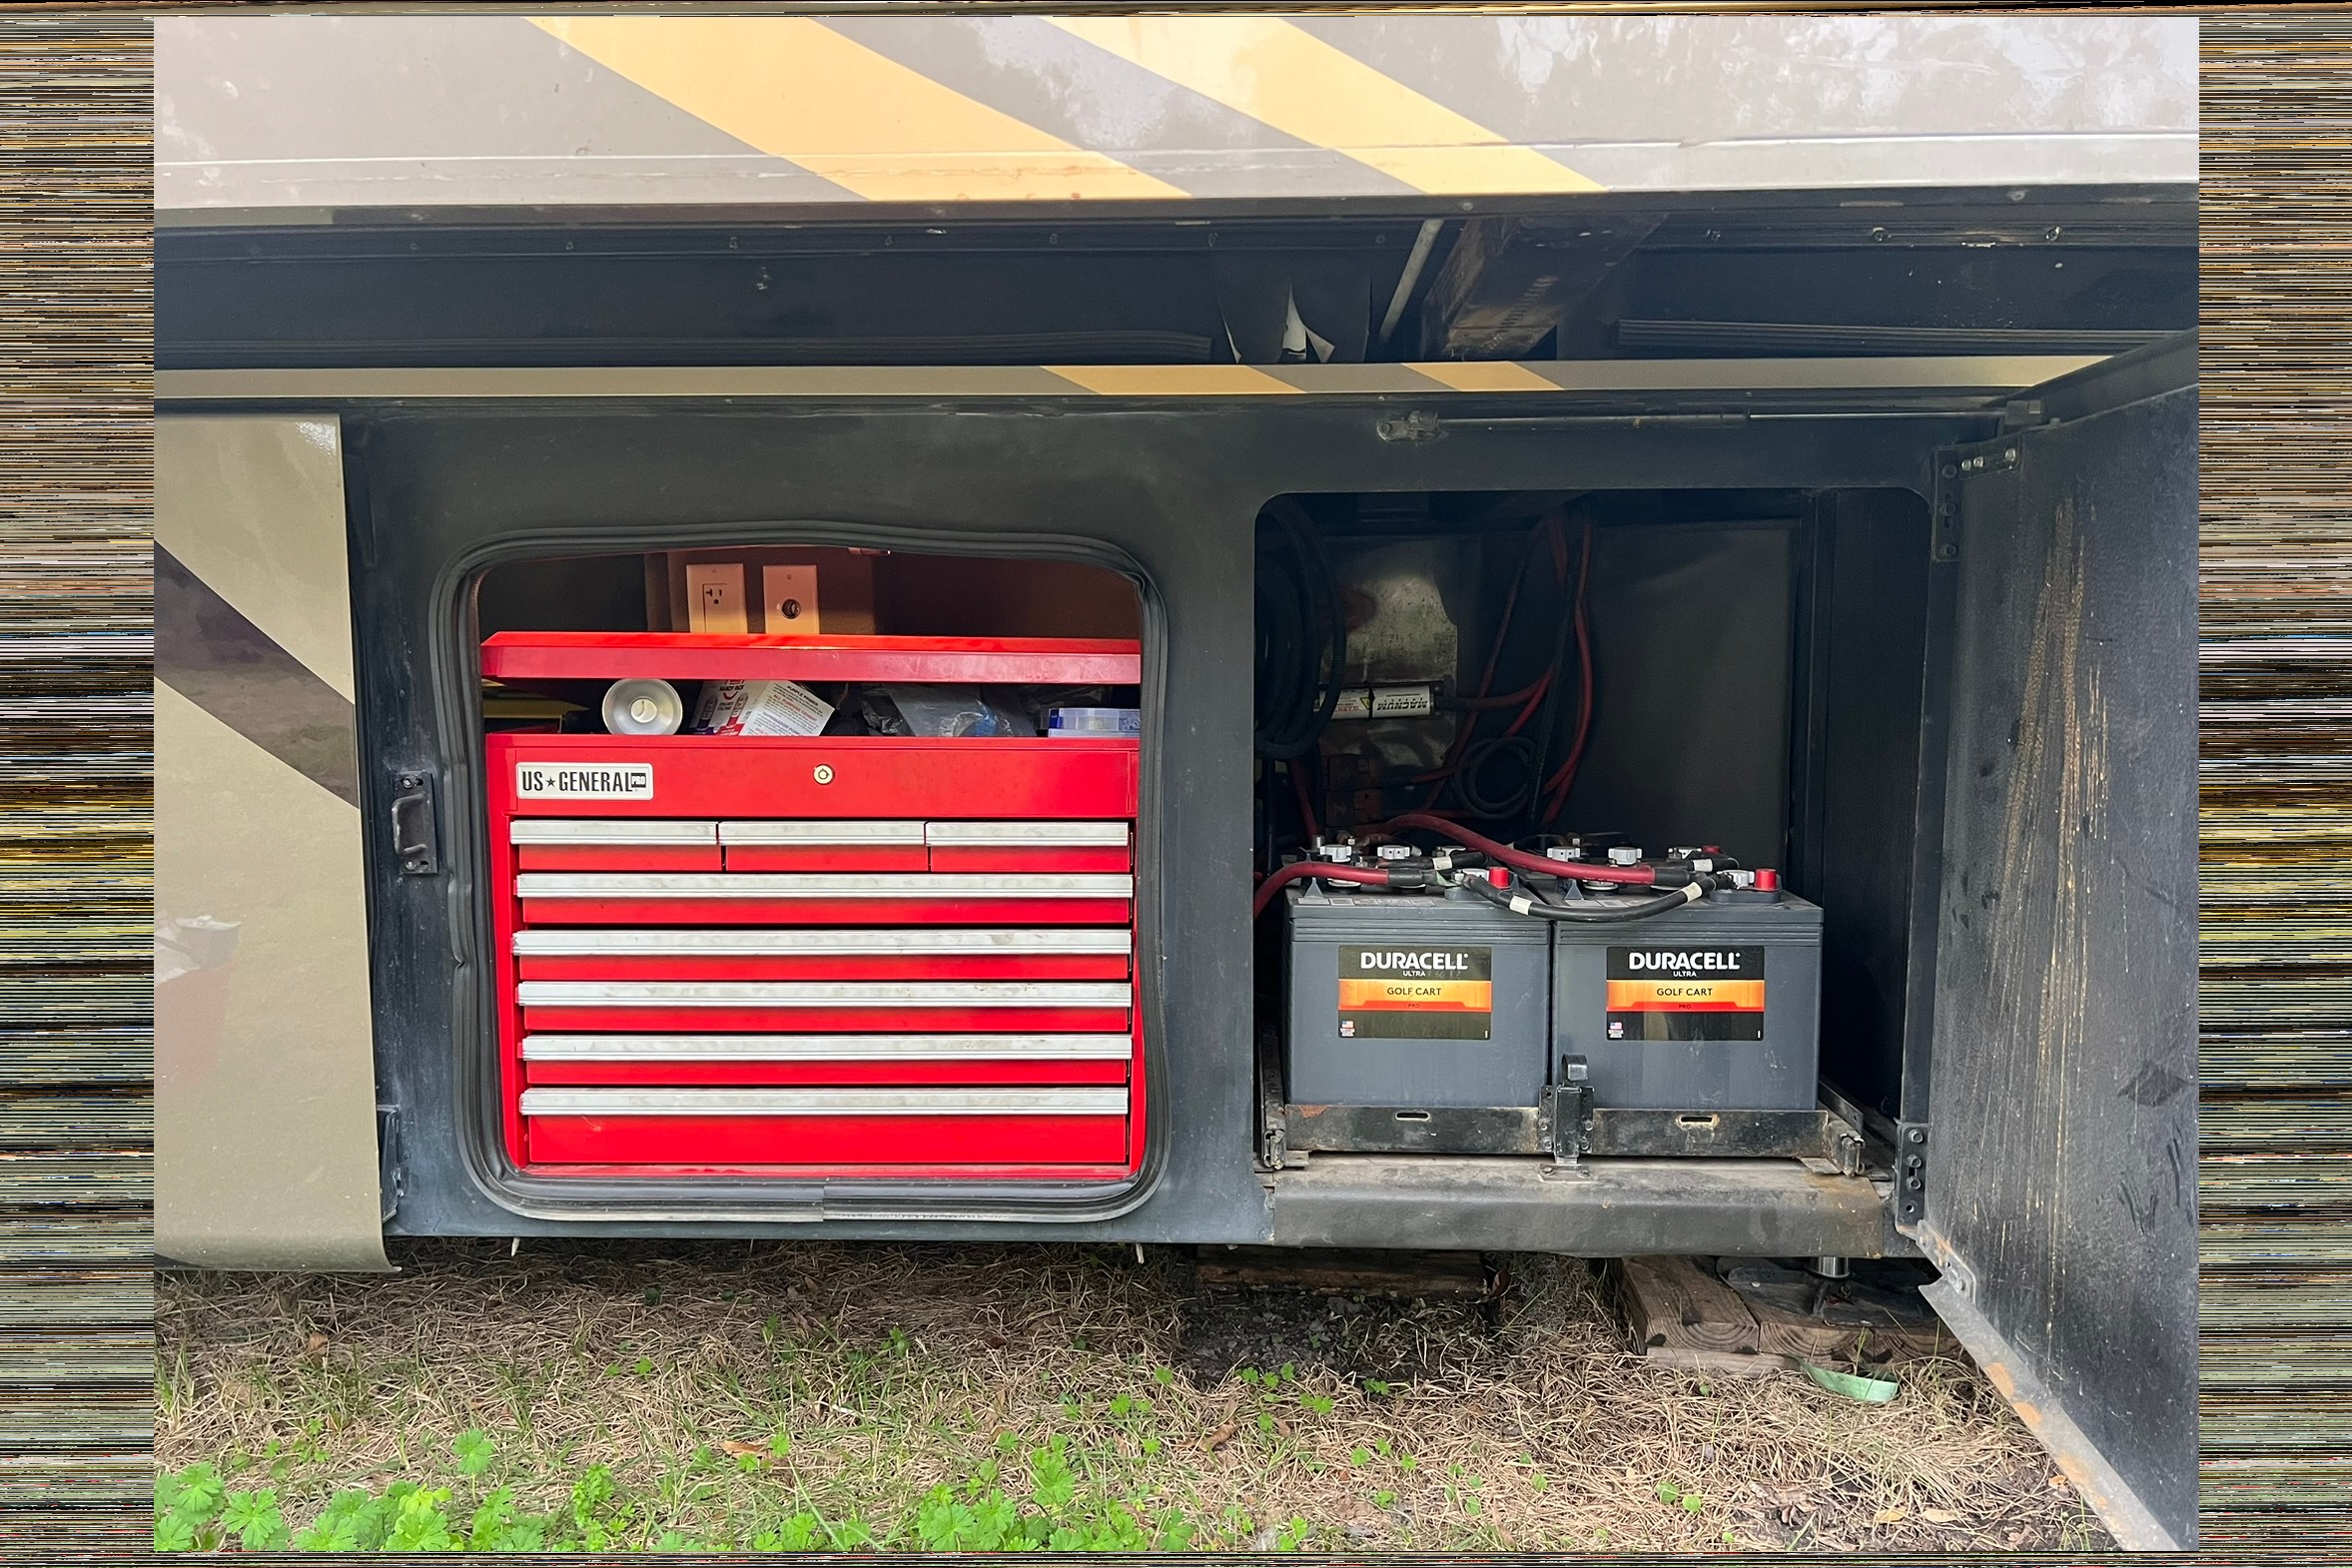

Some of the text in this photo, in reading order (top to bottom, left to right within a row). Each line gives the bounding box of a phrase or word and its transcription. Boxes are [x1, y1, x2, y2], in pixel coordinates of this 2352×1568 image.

[522, 771, 645, 792] US GENERAL PRO
[1360, 952, 1469, 970] DURACELL
[1629, 952, 1741, 970] DURACELL
[1386, 987, 1442, 996] GOLF CART
[1656, 988, 1713, 997] GOLF CART
